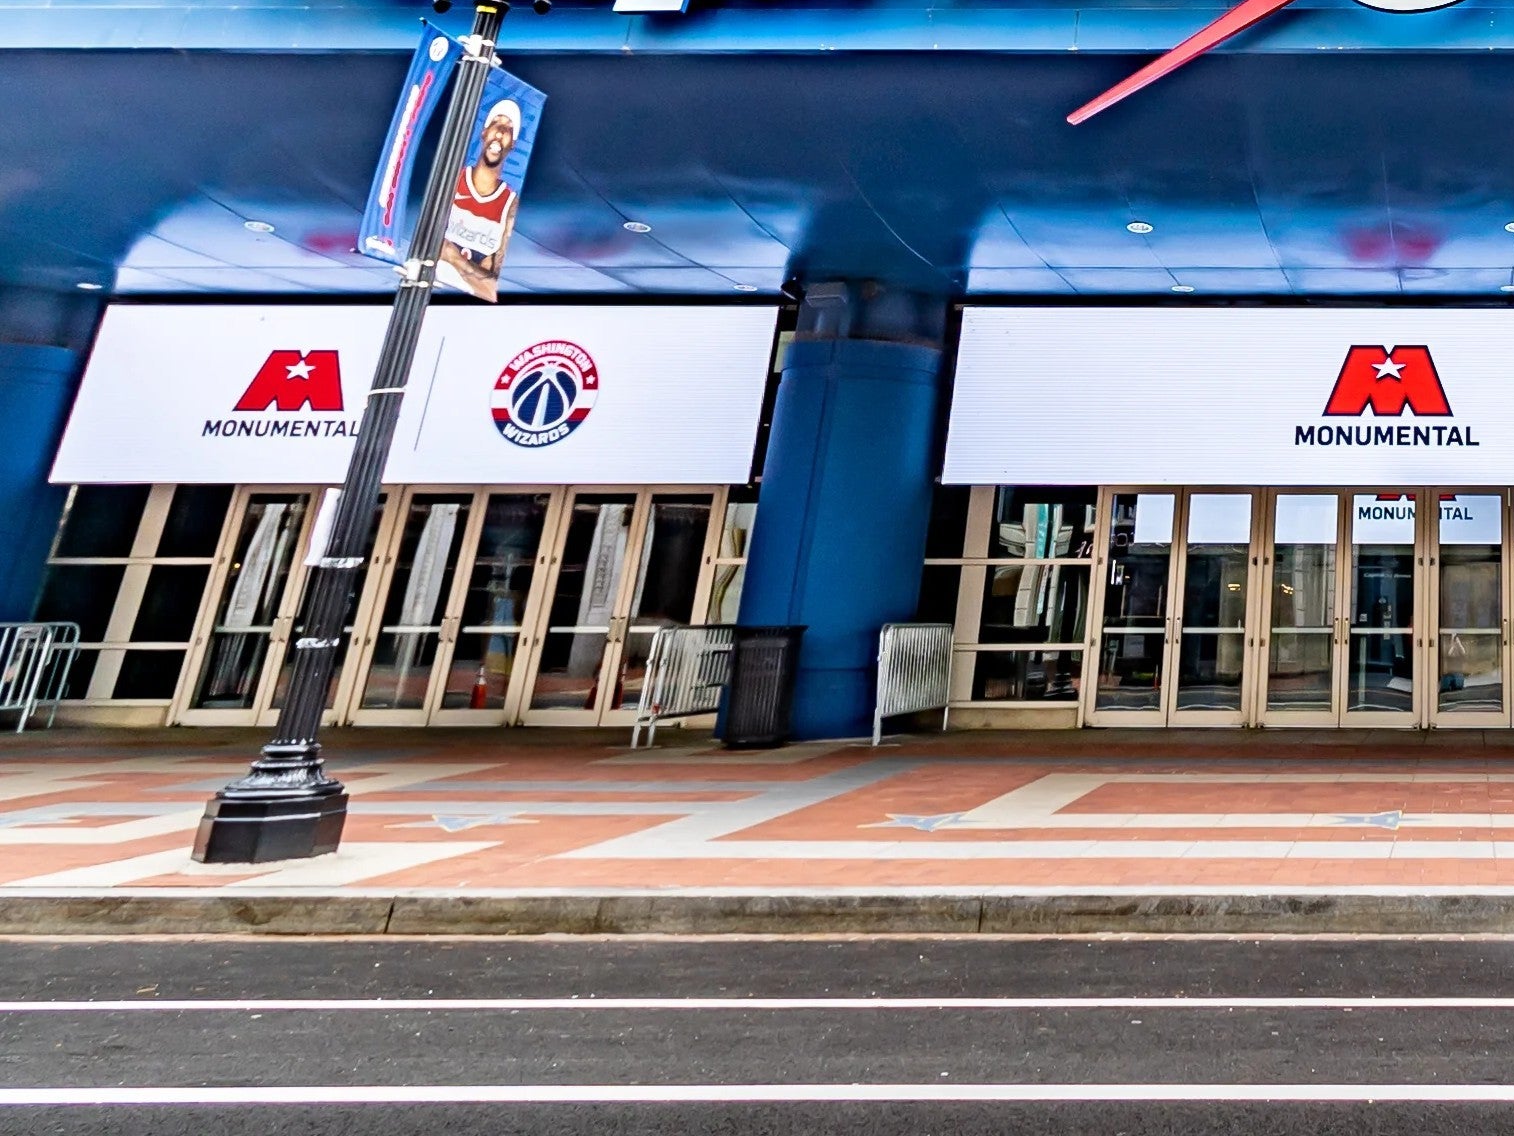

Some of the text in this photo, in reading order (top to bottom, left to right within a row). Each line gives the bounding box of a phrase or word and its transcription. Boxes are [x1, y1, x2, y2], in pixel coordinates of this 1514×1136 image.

[508, 342, 593, 373] WASHINGTON
[202, 420, 361, 437] MONUMENTAL
[502, 423, 569, 445] WIZARDS
[1294, 425, 1480, 448] MONUMENTAL
